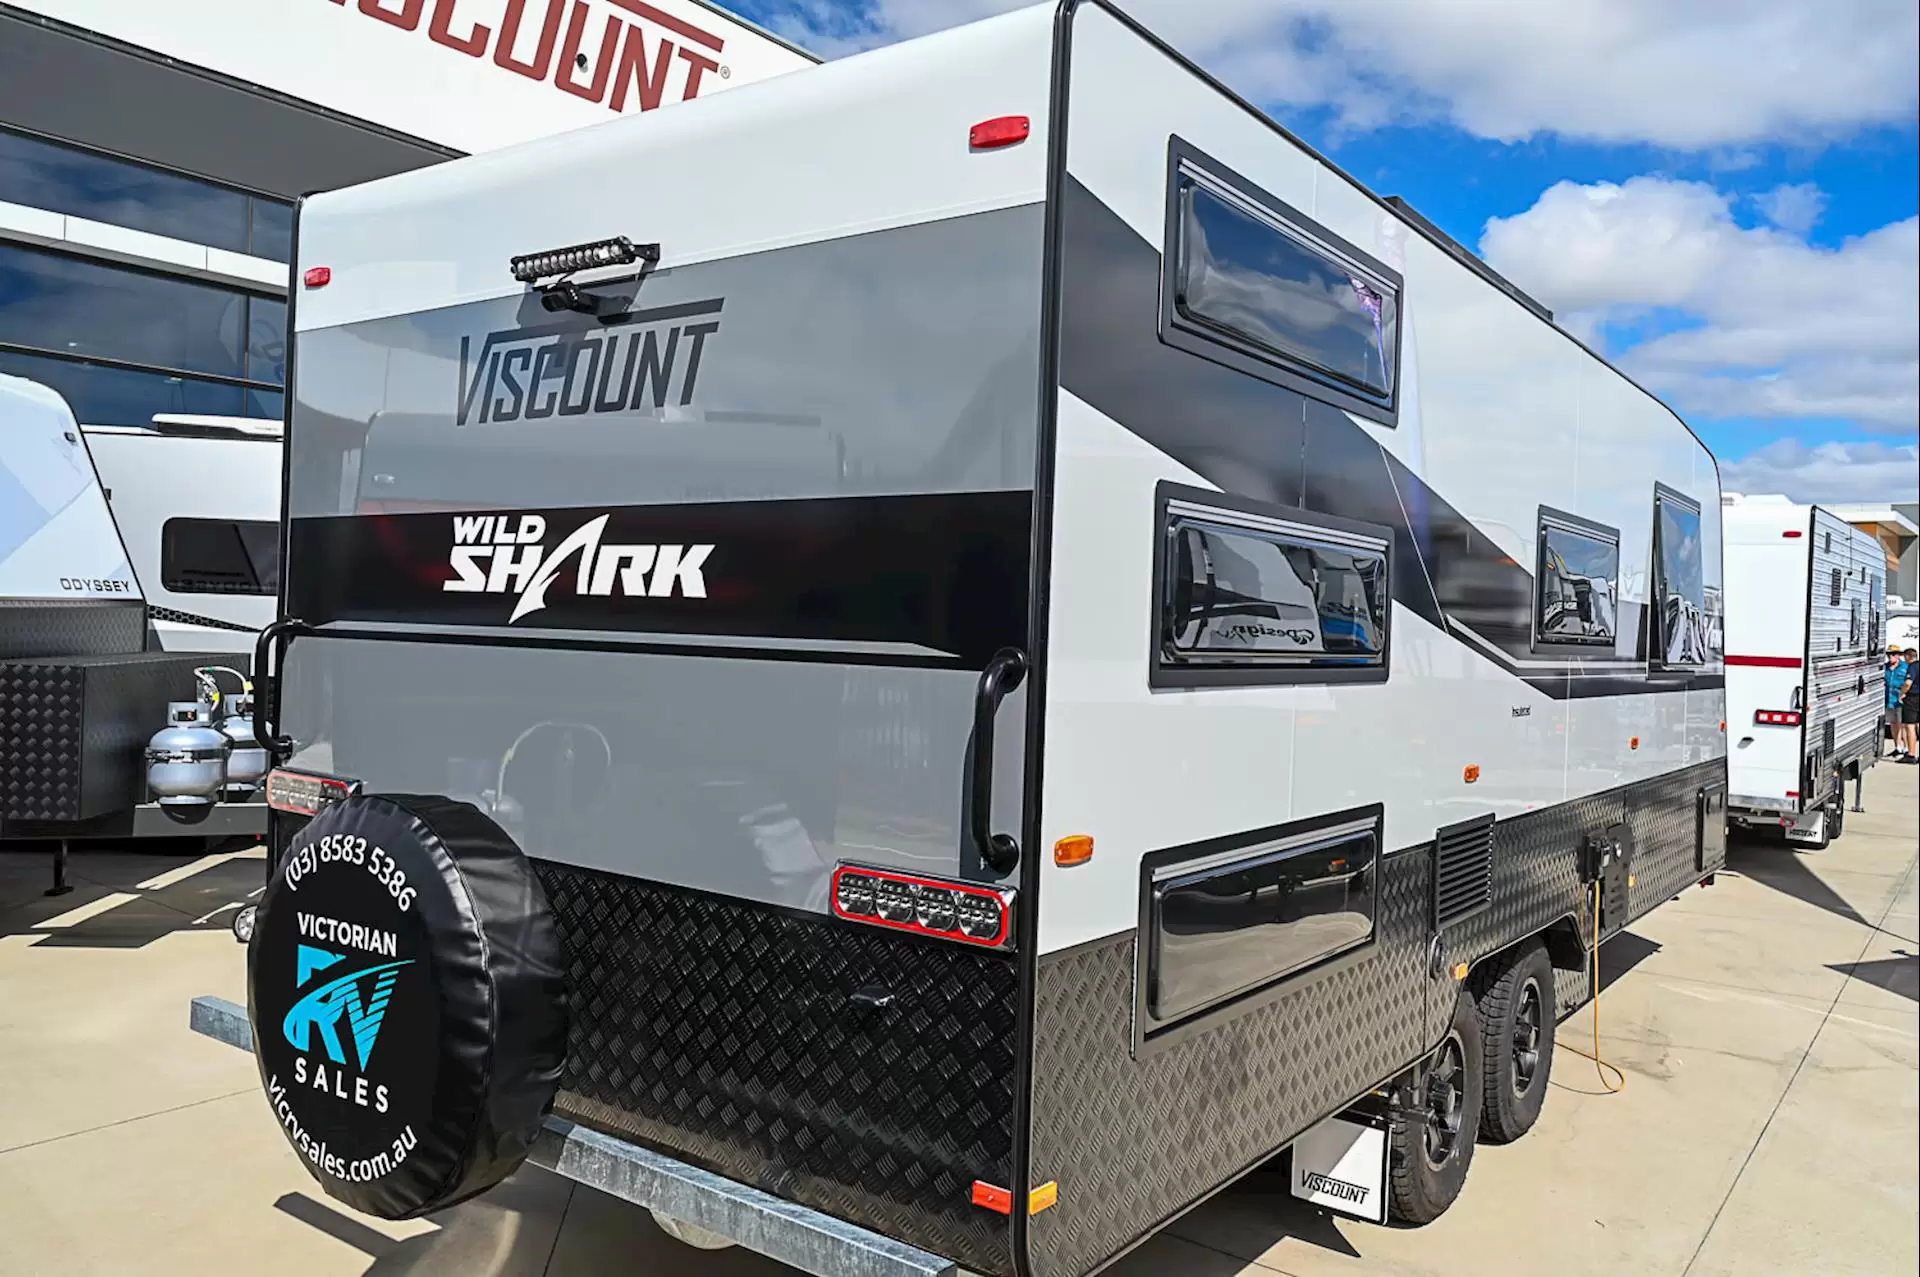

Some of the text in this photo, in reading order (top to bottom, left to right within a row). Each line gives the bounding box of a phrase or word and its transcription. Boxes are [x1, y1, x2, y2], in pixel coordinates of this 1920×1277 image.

[456, 297, 725, 426] VISCOUNT
[453, 514, 546, 544] WILD
[60, 578, 129, 592] ODYSSEY
[443, 513, 716, 625] SHARK
[285, 834, 418, 912] (03) 8583 5386
[297, 911, 397, 958] VICTORIAN
[295, 1056, 390, 1114] SALES
[268, 1074, 419, 1183] vicrvsales.com.au
[1301, 1168, 1371, 1205] VISCOUNT
